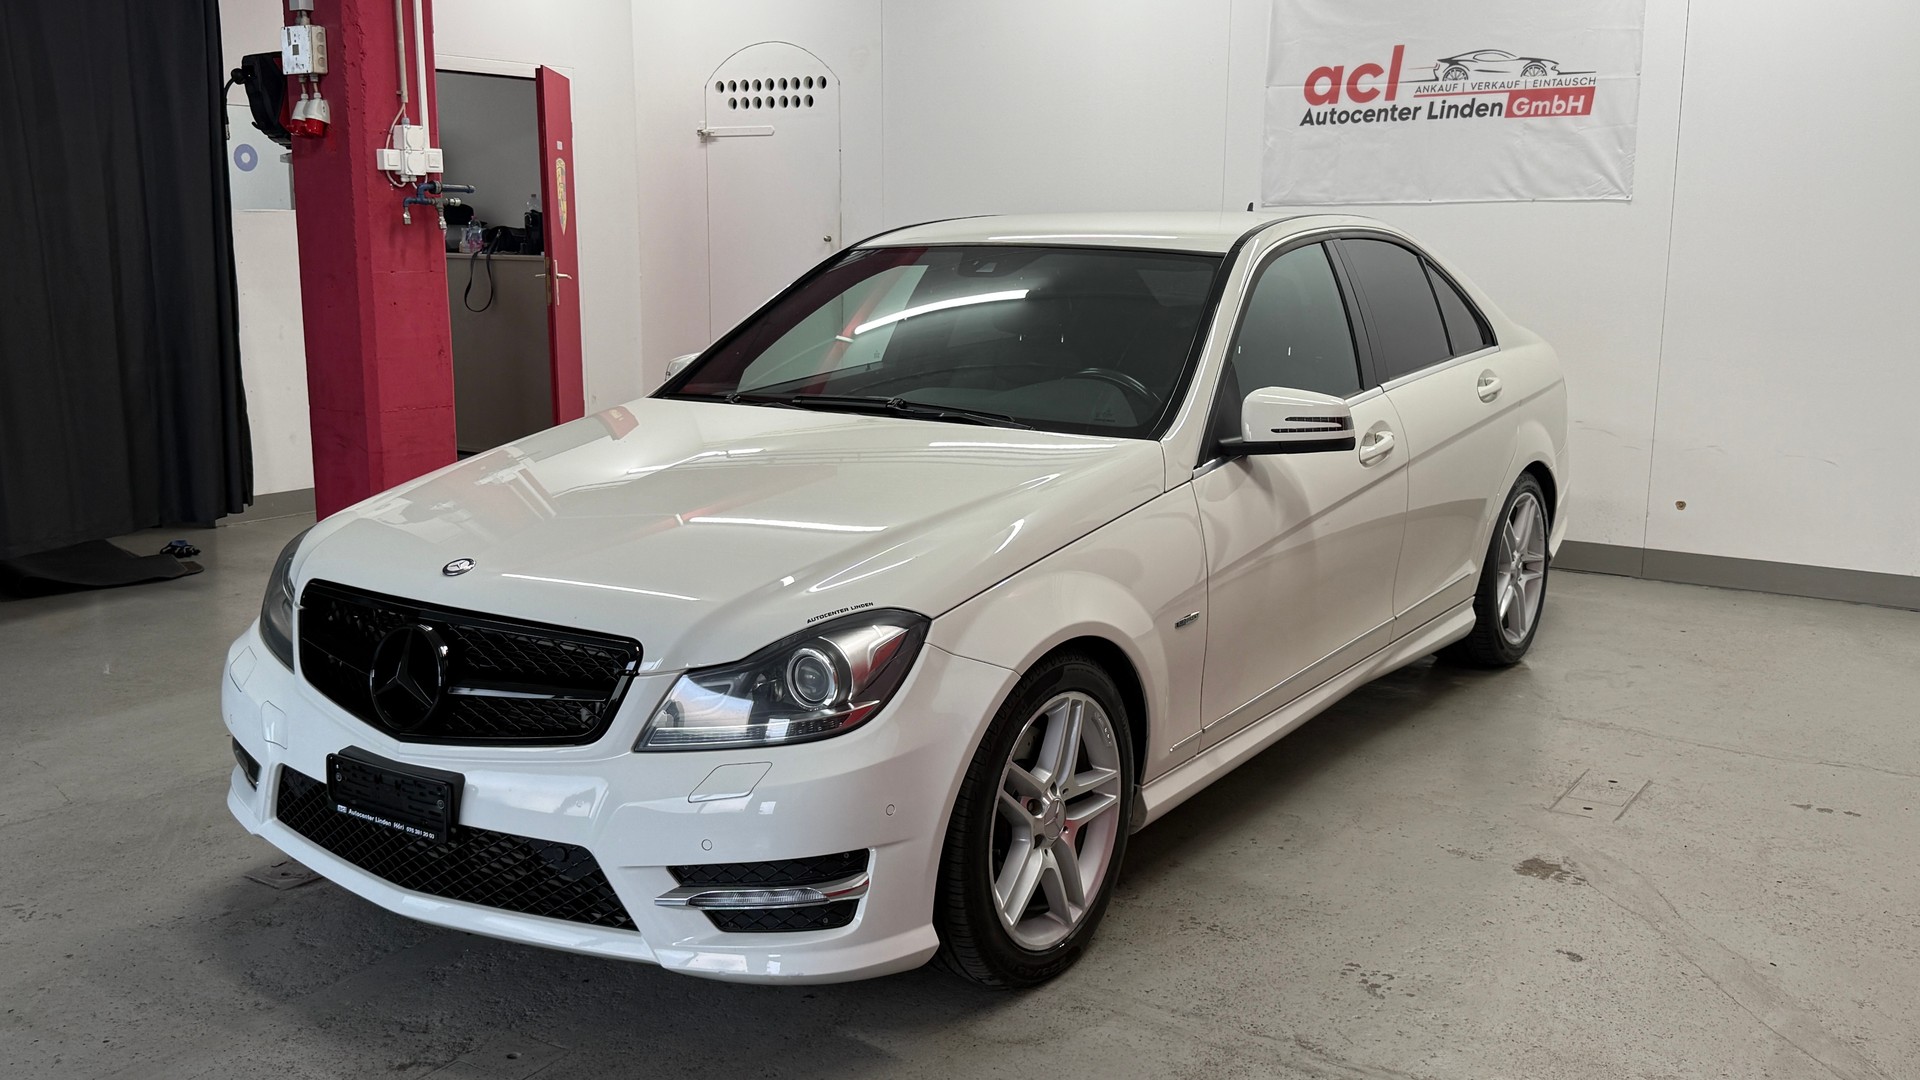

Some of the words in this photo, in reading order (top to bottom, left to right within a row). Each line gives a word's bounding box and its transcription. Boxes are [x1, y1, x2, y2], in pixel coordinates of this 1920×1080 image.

[1303, 44, 1405, 106] acl
[1415, 83, 1459, 94] ANKAUF
[1470, 80, 1521, 90] VERKAUF
[1532, 77, 1597, 88] EINTAUSCH
[1299, 104, 1422, 127] Autocenter
[1427, 98, 1503, 120] Linden
[1512, 94, 1585, 116] GmbH
[806, 607, 849, 624] AUTOCENTER
[850, 602, 874, 611] LINDEN
[348, 808, 374, 821] Autocenter
[375, 816, 391, 826] Linden
